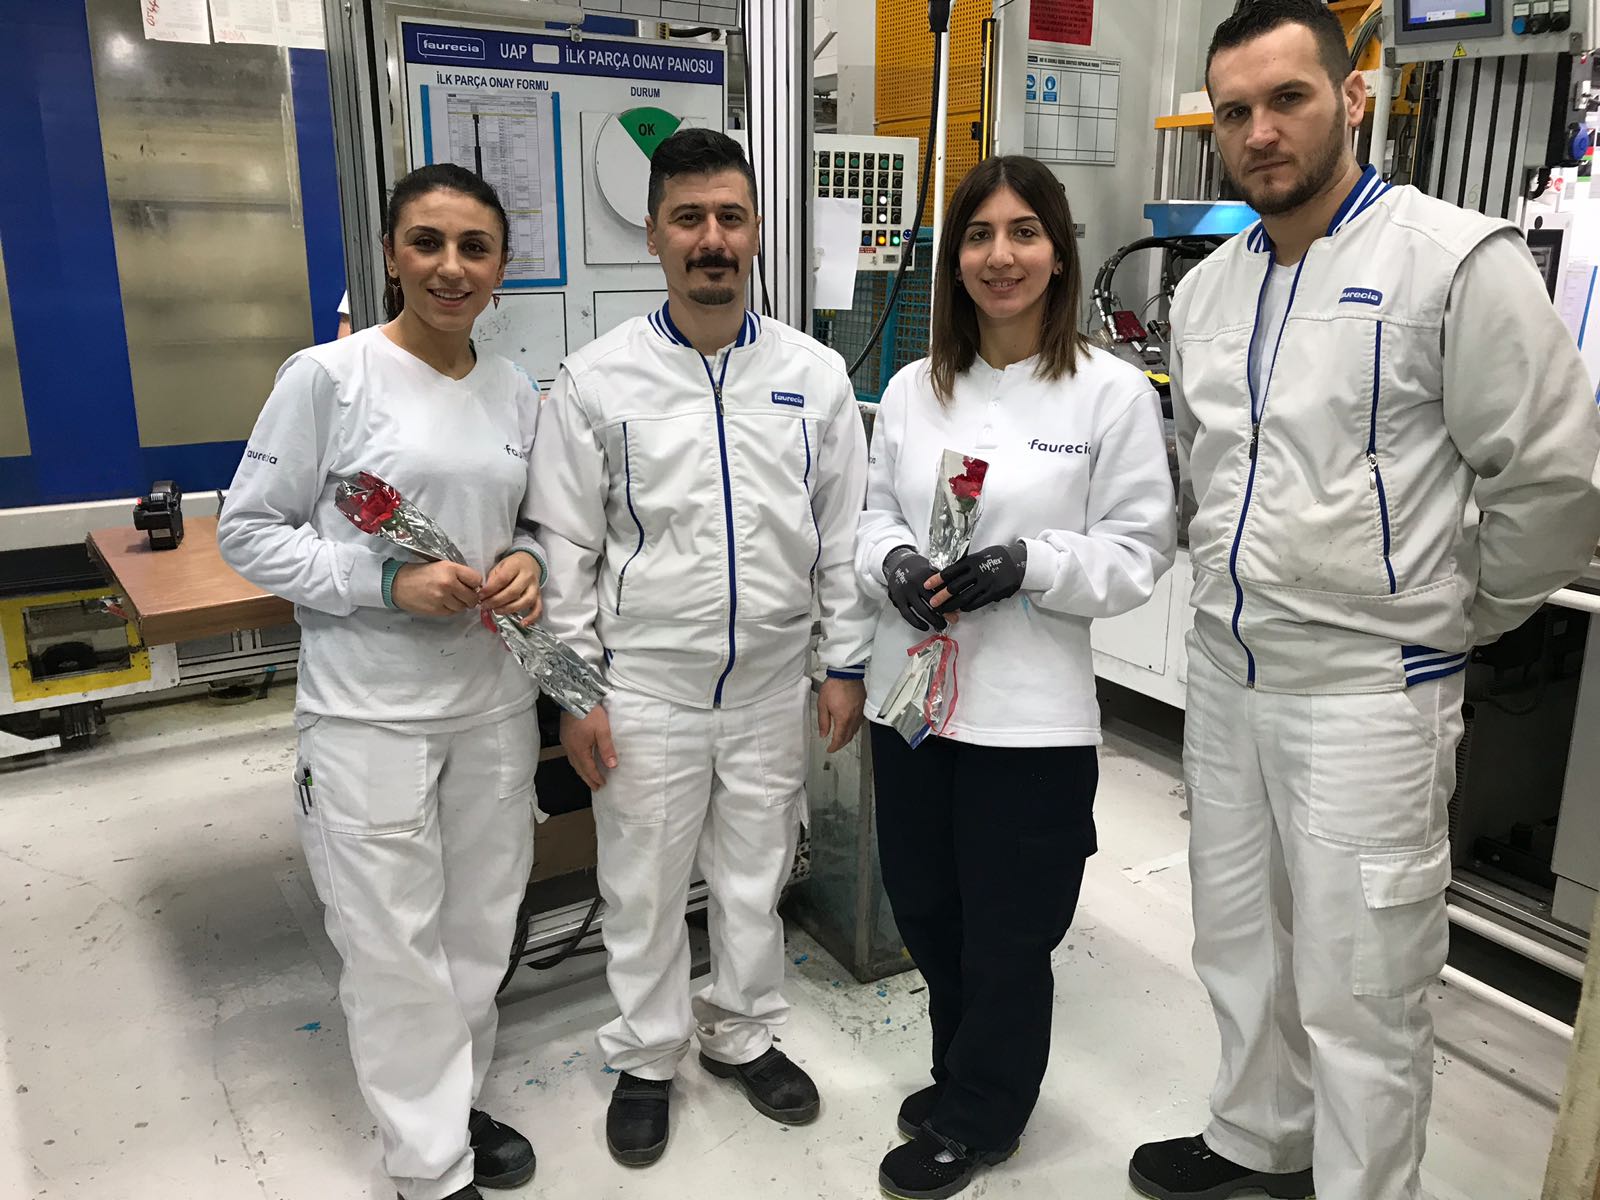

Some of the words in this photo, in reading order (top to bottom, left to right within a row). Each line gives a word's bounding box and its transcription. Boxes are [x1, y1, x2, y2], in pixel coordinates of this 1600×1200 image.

[423, 40, 480, 53] faurecia
[500, 42, 527, 60] UAP
[565, 44, 586, 65] İLK
[588, 50, 630, 70] PARÇA
[632, 53, 665, 70] ONAY
[667, 56, 714, 74] PANOSU
[436, 70, 453, 85] İLK
[454, 74, 487, 89] PARÇA
[489, 77, 515, 89] ONAY
[516, 78, 549, 91] FORMU
[630, 86, 660, 98] DURUM
[638, 123, 656, 136] OK
[773, 393, 803, 404] faurecia
[978, 557, 1003, 573] HyFlex
